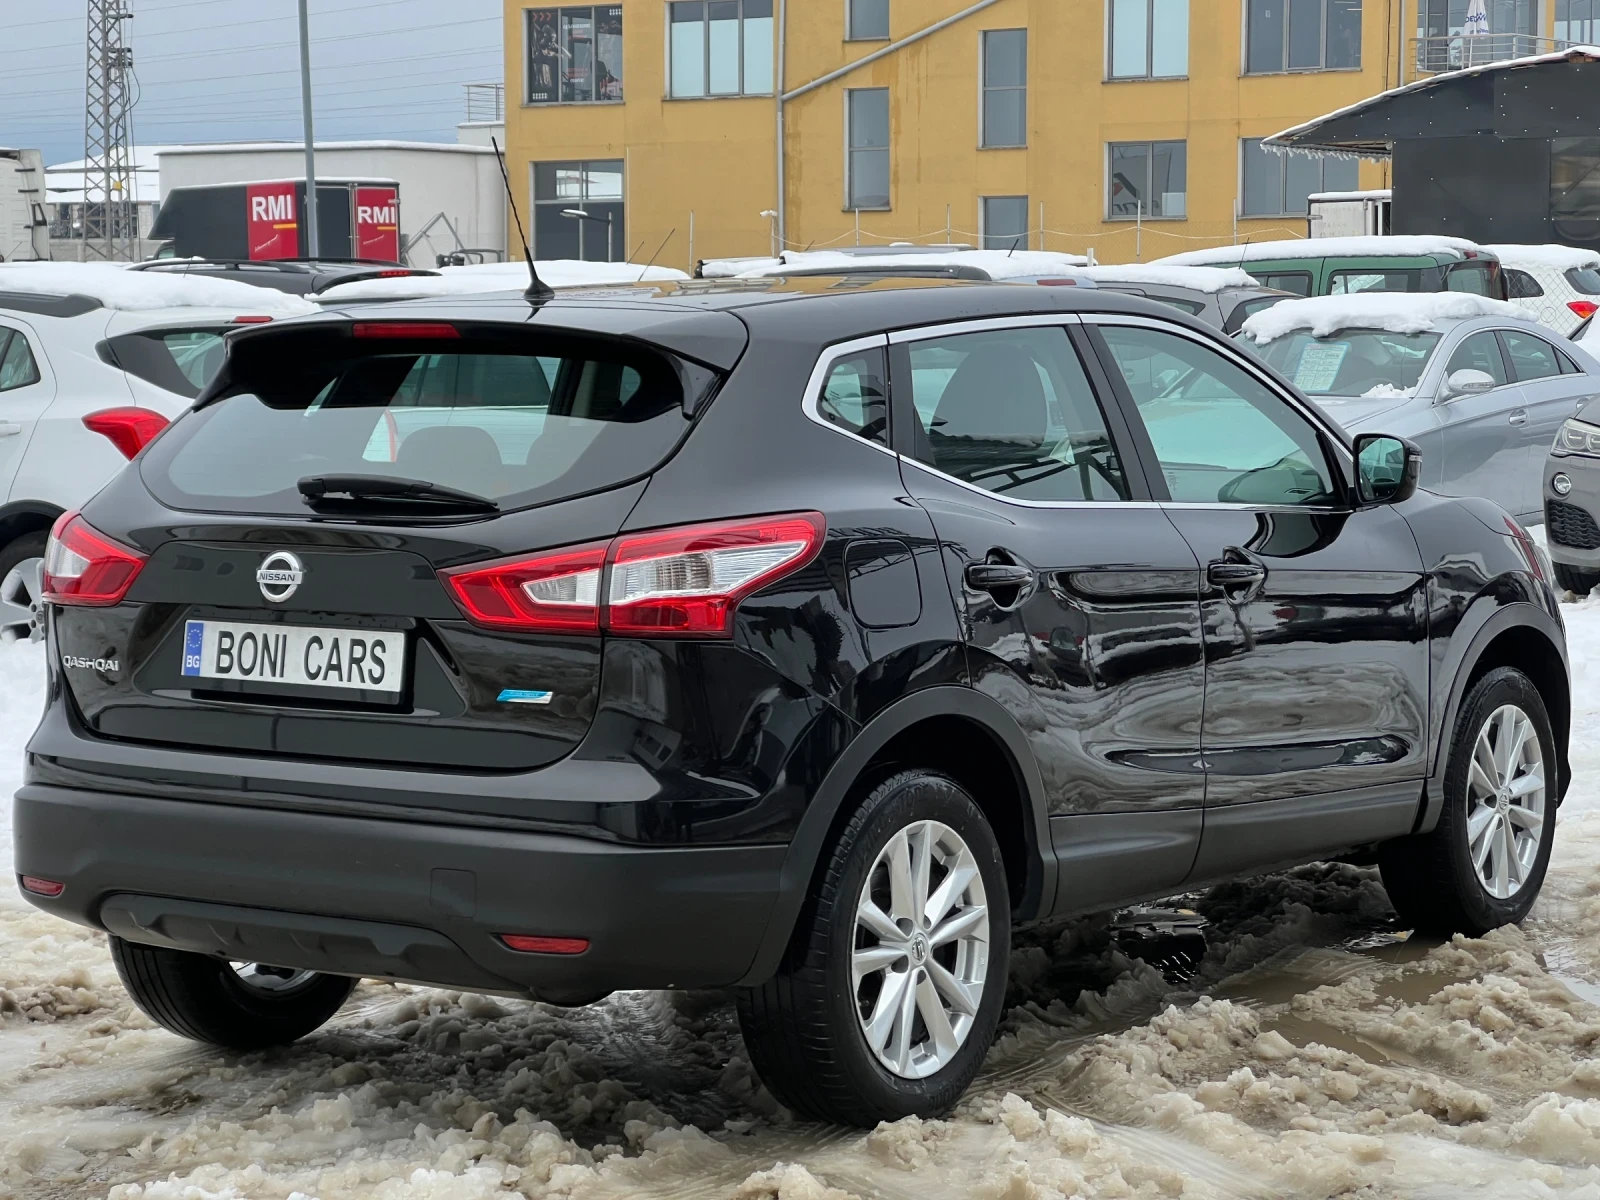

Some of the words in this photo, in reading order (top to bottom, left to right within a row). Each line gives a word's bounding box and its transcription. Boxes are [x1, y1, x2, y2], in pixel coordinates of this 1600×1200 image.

[251, 194, 293, 222] RMI
[357, 206, 396, 224] RMI
[260, 573, 296, 582] NISSAN
[63, 655, 119, 672] QASHQAI
[186, 655, 200, 668] BG
[215, 630, 288, 678] BONI
[303, 635, 387, 685] CARS
